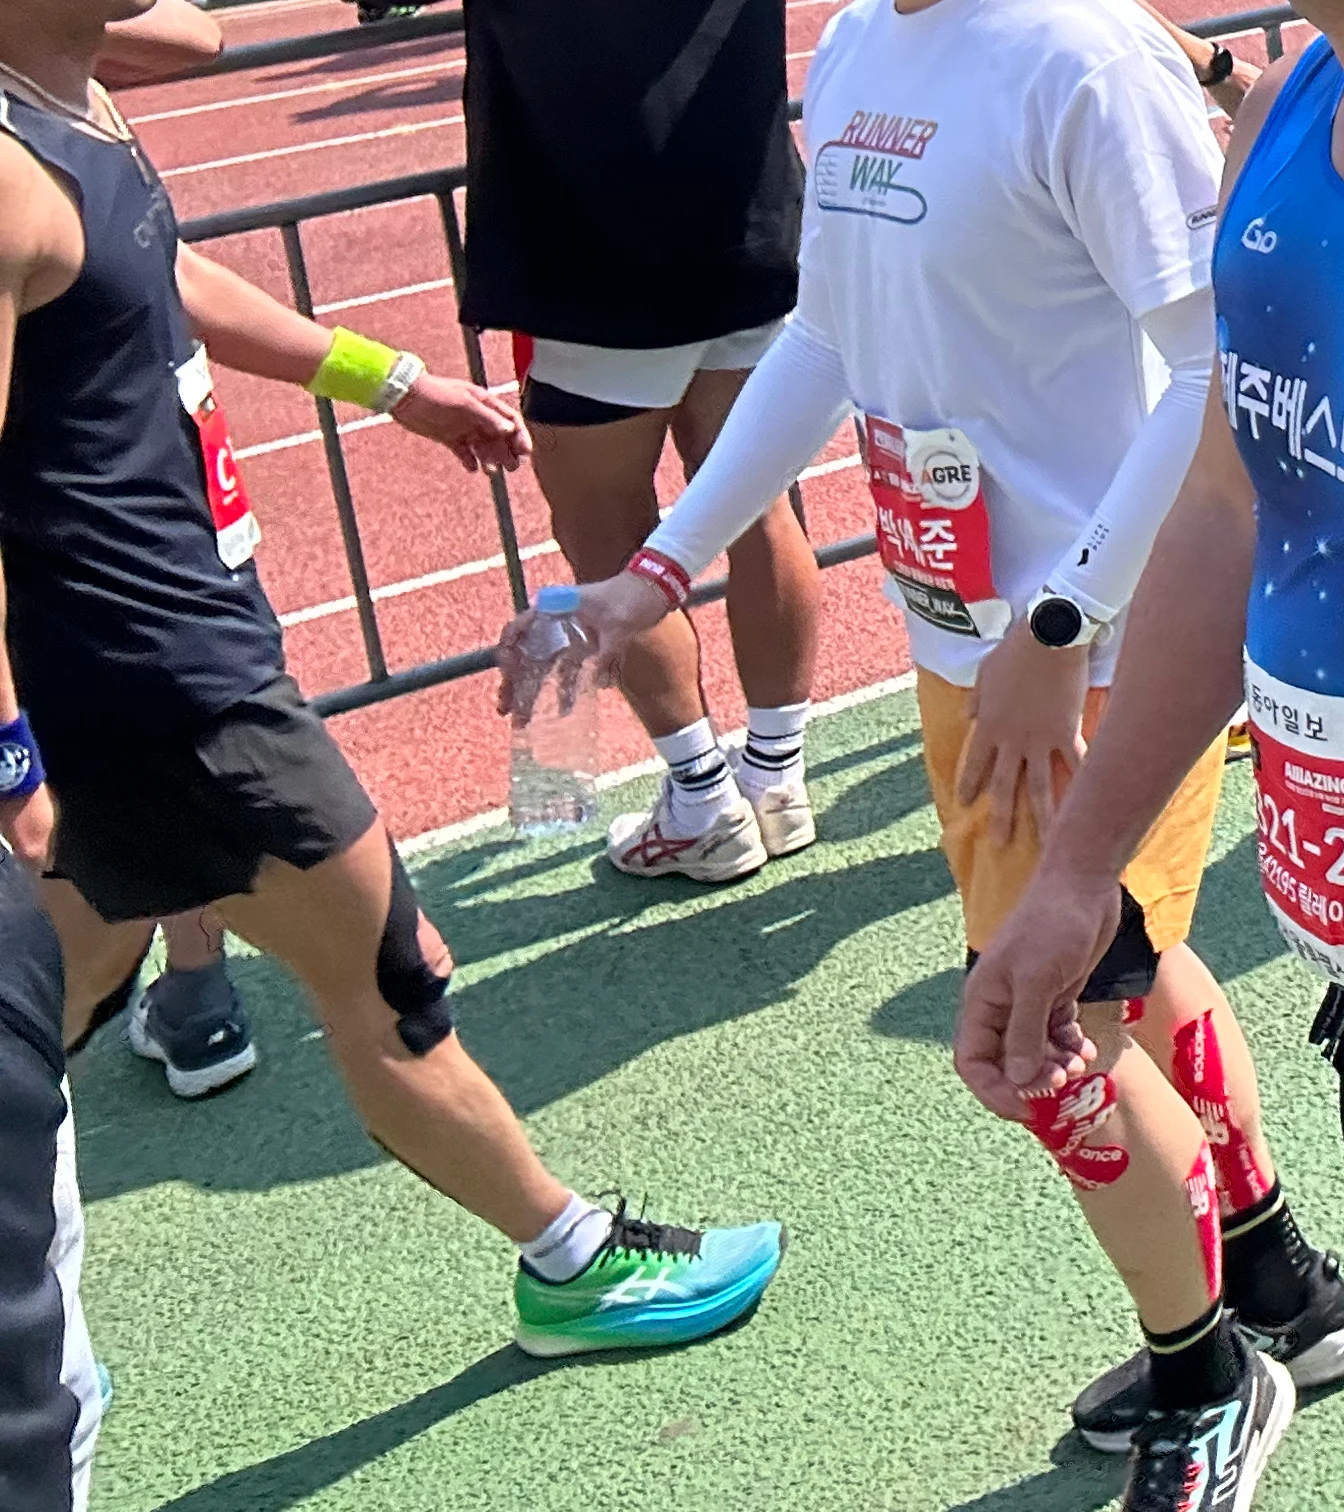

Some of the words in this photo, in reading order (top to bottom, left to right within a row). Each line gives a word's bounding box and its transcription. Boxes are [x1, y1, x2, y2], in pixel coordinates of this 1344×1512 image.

[842, 110, 938, 157] RUNNER
[849, 154, 904, 197] WAY
[1251, 682, 1329, 742] 동아일보
